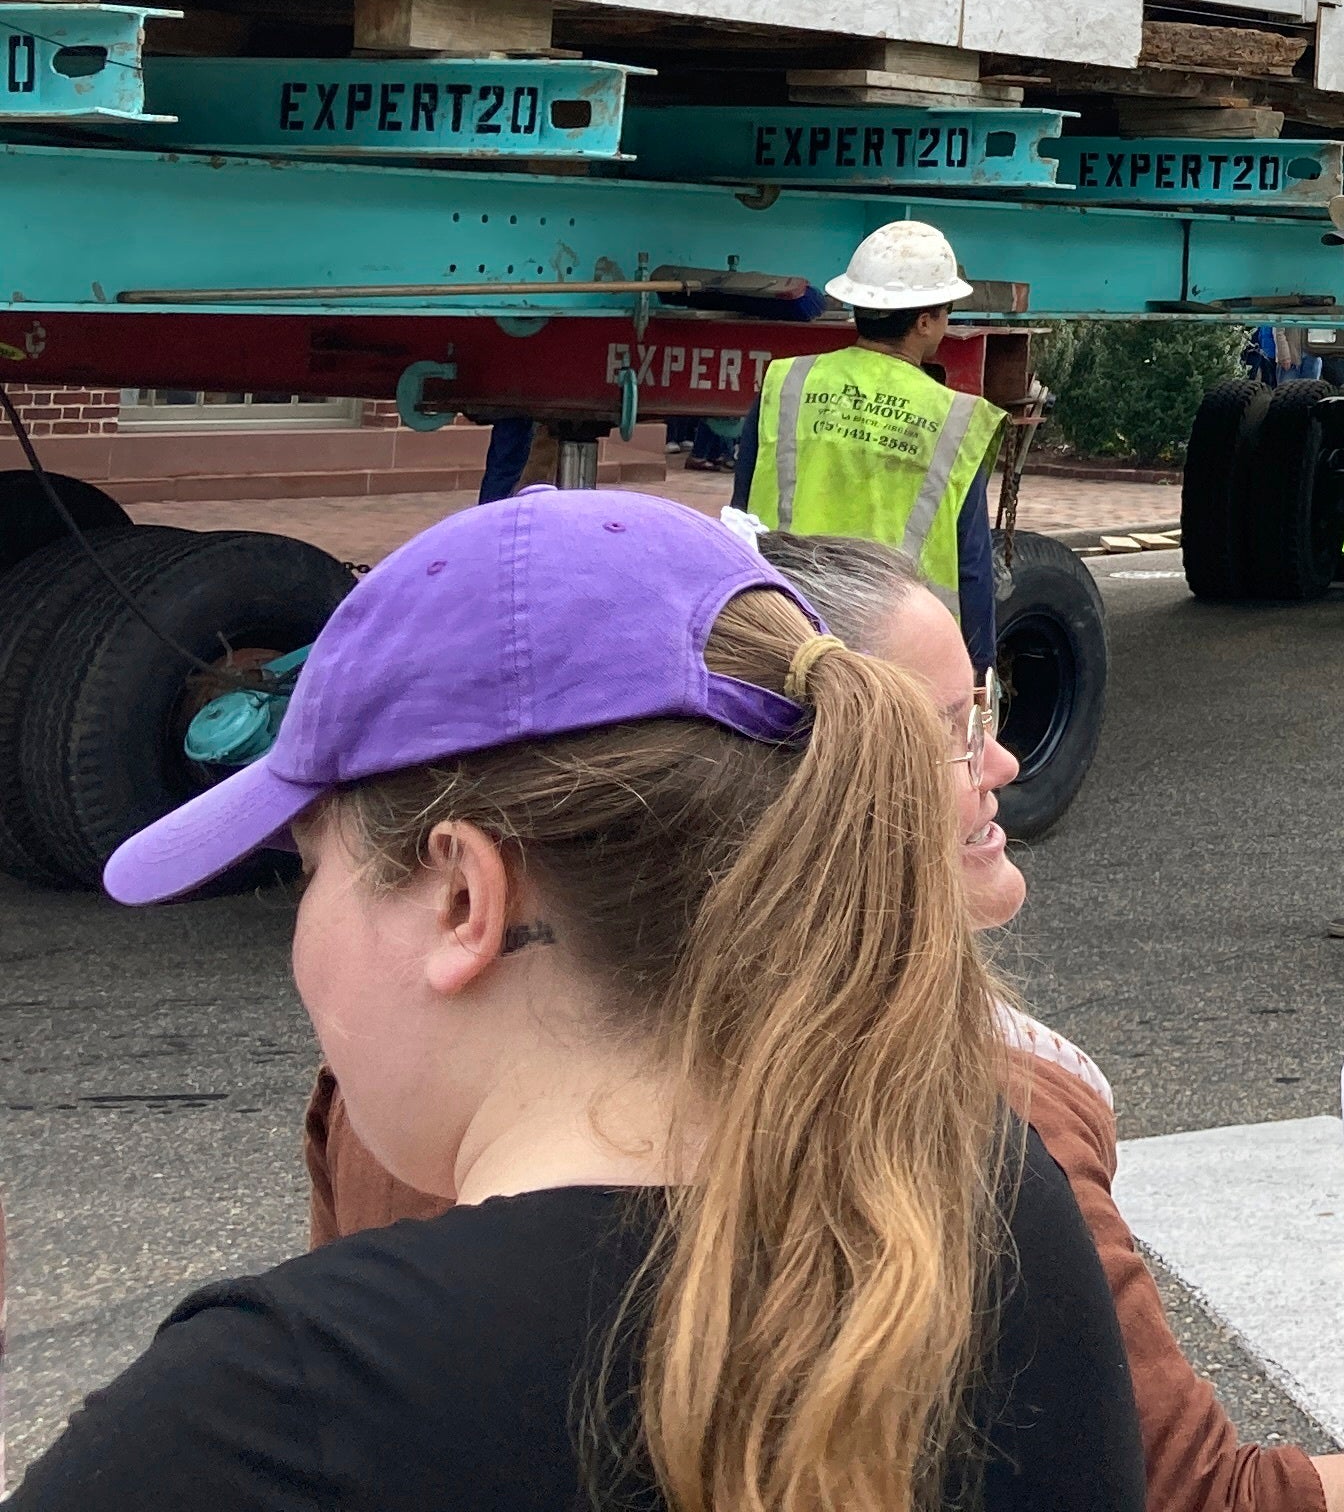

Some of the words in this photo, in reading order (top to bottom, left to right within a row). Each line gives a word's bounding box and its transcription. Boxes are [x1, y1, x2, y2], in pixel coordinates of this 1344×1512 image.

[280, 81, 538, 135] EXPERT20
[755, 125, 970, 168] EXPERT20
[1080, 151, 1281, 191] EXPERT20
[606, 342, 773, 393] EXPERT
[863, 402, 940, 434] MOVERS
